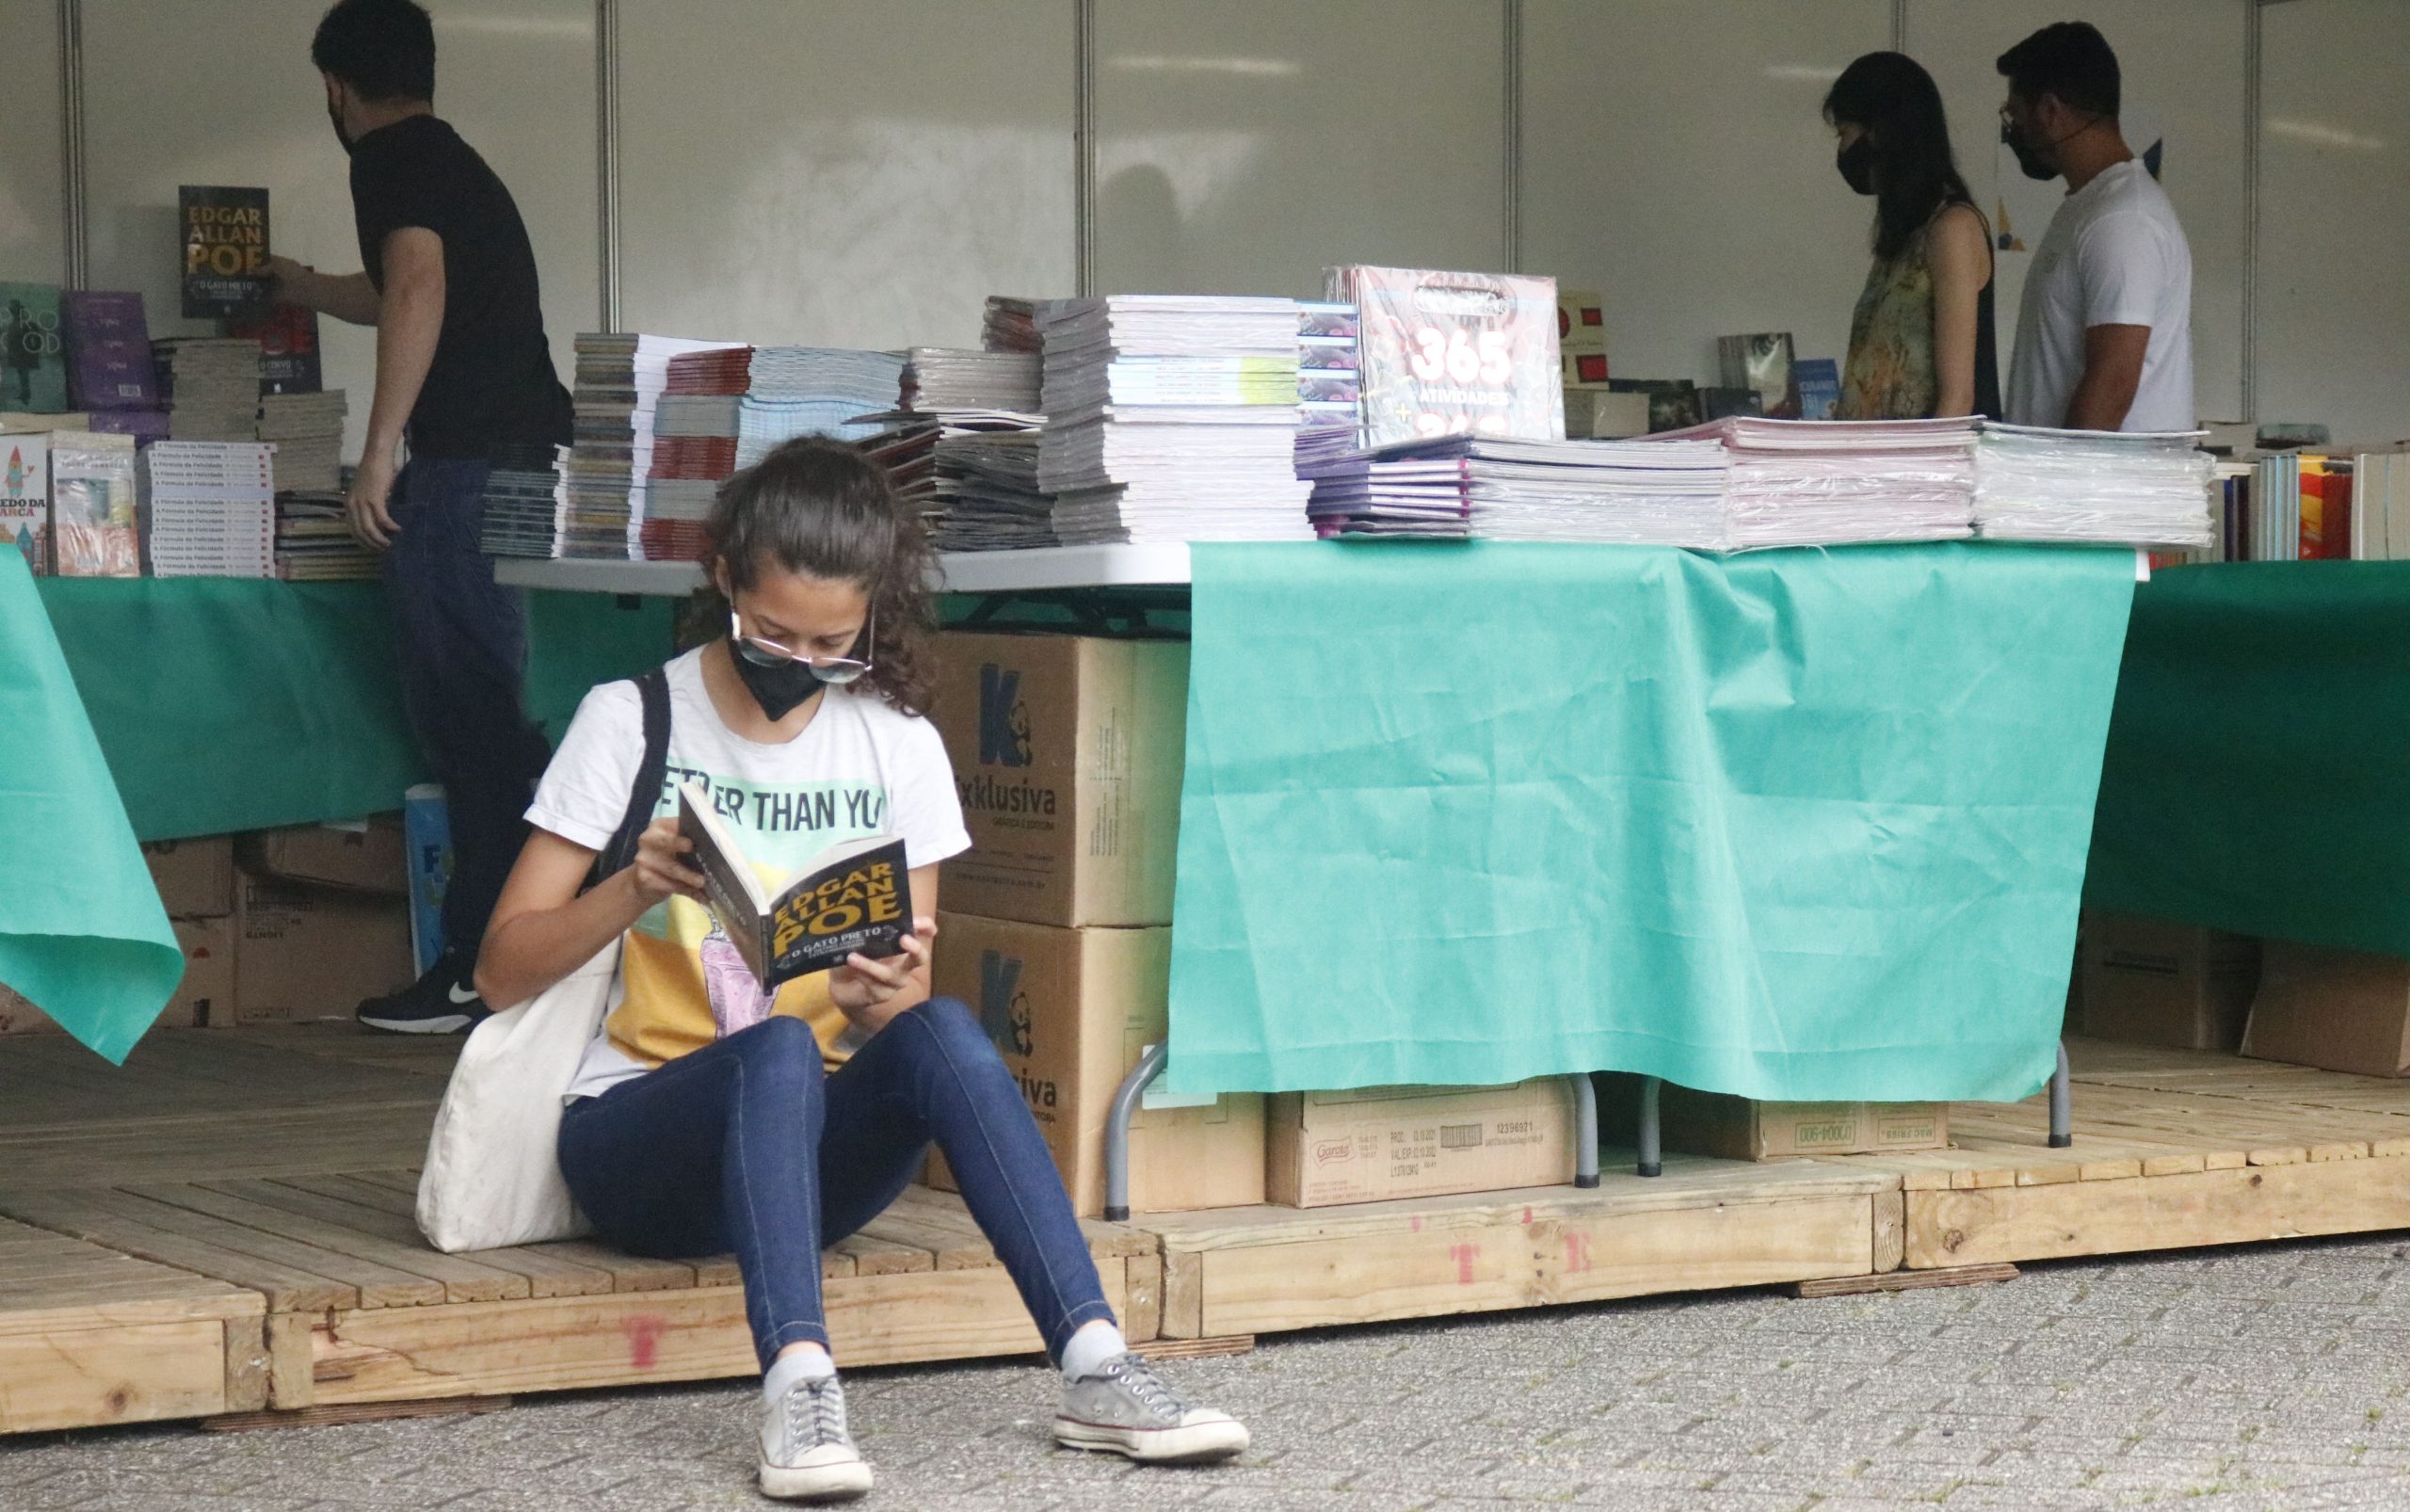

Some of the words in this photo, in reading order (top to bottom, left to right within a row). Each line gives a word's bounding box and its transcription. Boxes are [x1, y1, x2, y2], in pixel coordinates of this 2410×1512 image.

[188, 206, 262, 225] EDGAR
[189, 225, 261, 244] ALLAN
[187, 244, 264, 276] POE
[1412, 327, 1511, 384] 365
[1420, 387, 1510, 406] ATIVIDADES
[28, 498, 45, 507] DA
[753, 789, 835, 831] THAN
[956, 774, 1055, 815] xklusiva
[774, 861, 894, 924] EDGAR
[774, 877, 894, 938] ALLAN
[773, 891, 903, 958] POE
[791, 948, 800, 958] O
[803, 936, 838, 954] GATO
[841, 926, 881, 942] PRETO
[1497, 1121, 1534, 1134] 12396921
[1914, 1129, 1933, 1138] MAC
[1317, 1144, 1349, 1159] Garoto
